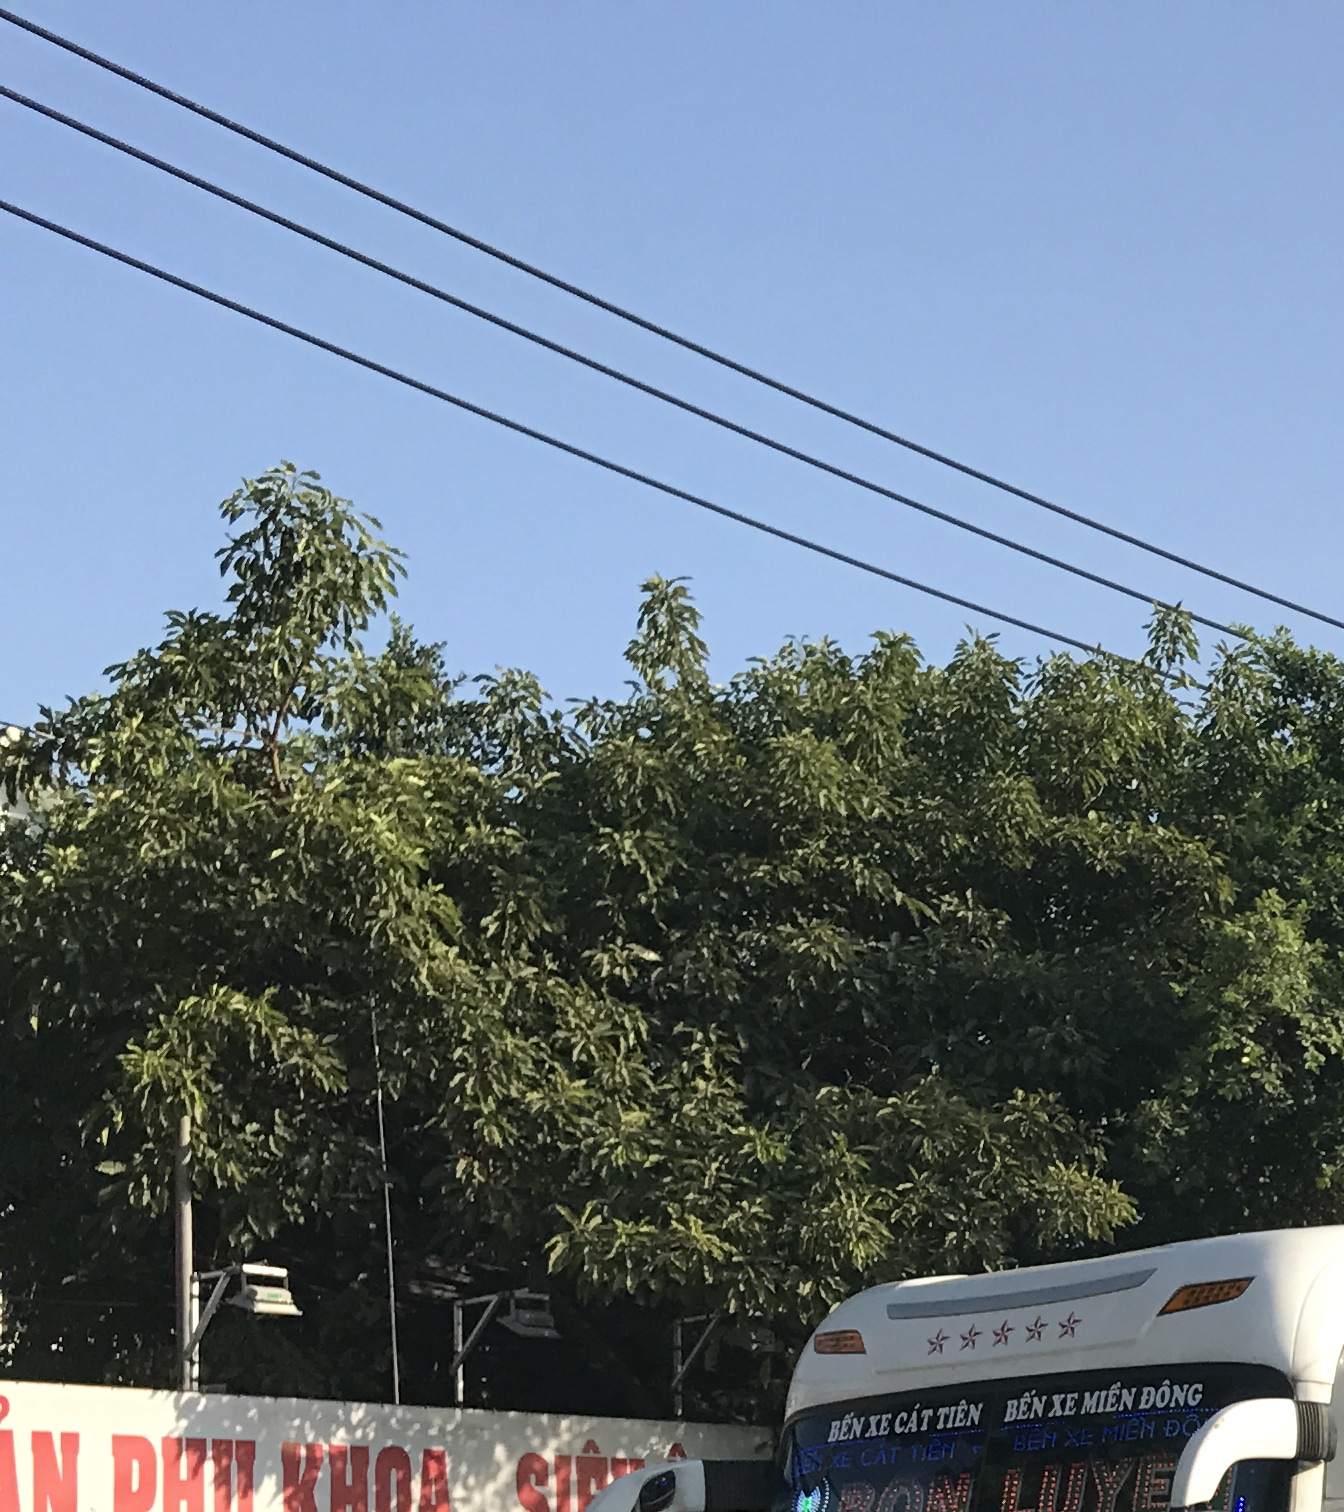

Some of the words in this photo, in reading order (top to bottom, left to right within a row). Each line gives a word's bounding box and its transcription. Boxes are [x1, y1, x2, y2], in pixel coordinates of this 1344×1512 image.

[827, 1412, 865, 1443] BẾN
[864, 1413, 893, 1438] XE
[894, 1403, 933, 1434] CÁT
[936, 1399, 984, 1430] TIÊN
[1004, 1389, 1047, 1423] BẾN
[1048, 1392, 1078, 1418] XE
[1080, 1381, 1137, 1415] MIỀN
[1138, 1379, 1204, 1411] ĐÔNG
[1064, 1427, 1094, 1448] XE
